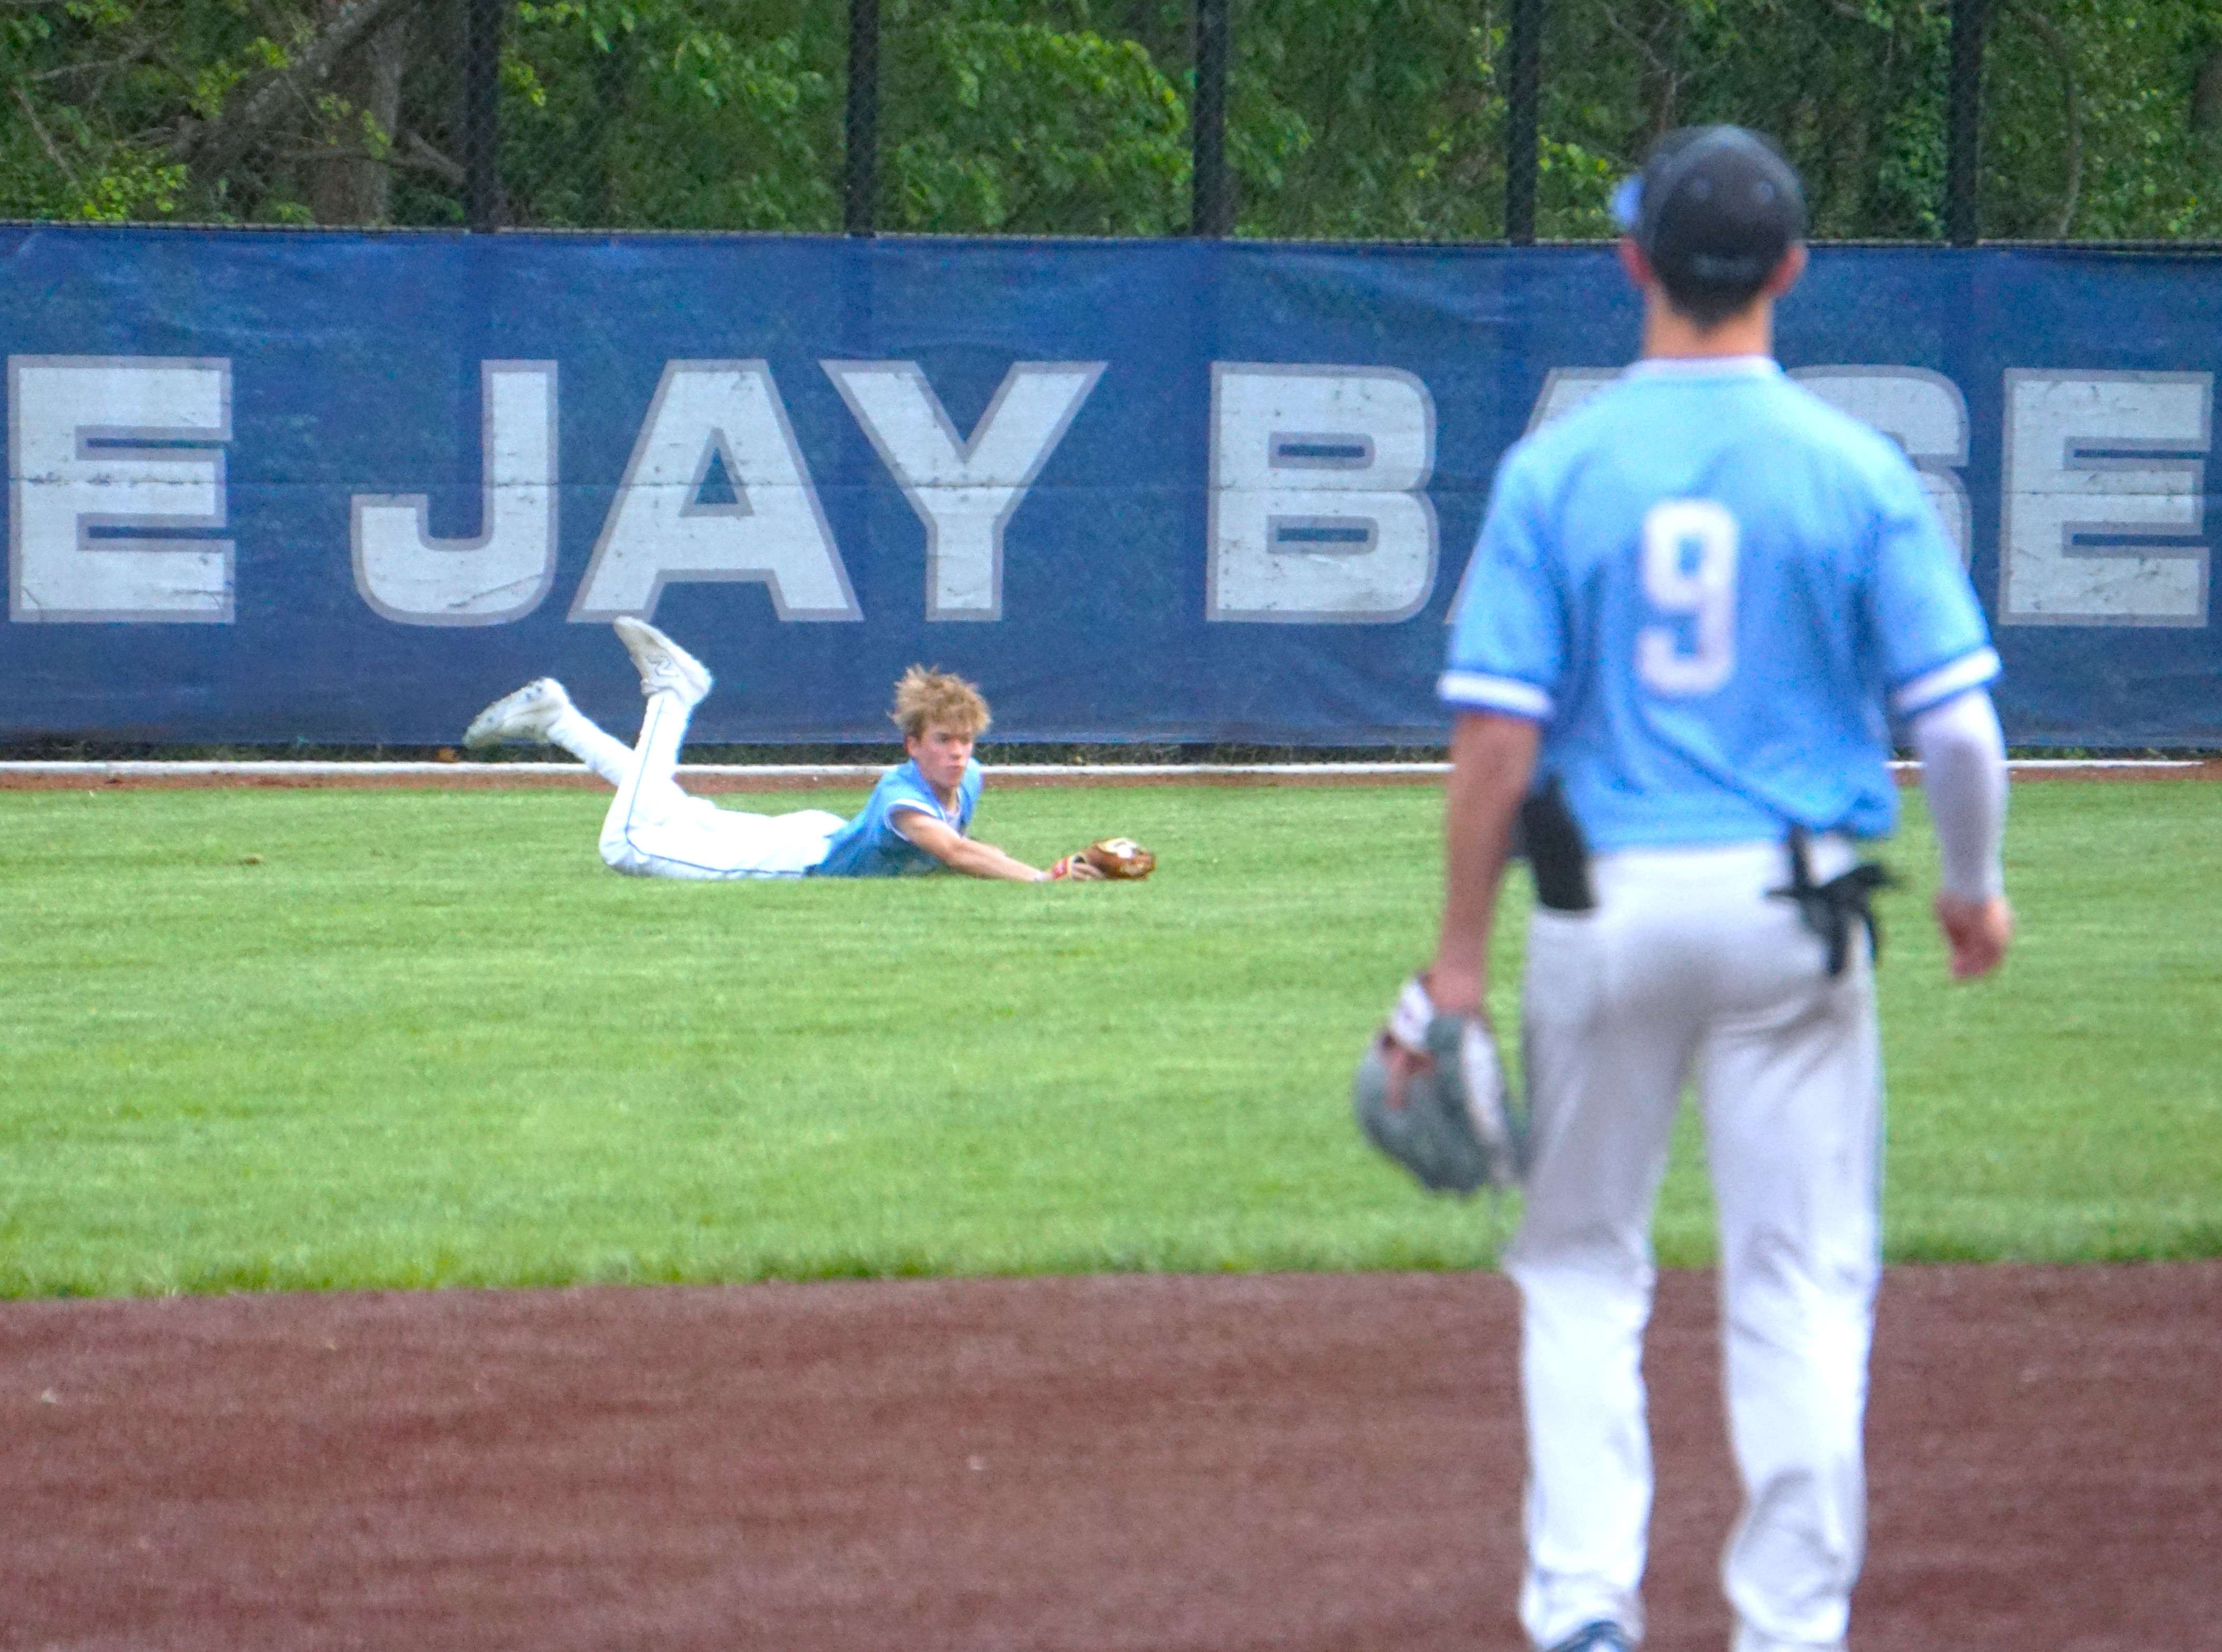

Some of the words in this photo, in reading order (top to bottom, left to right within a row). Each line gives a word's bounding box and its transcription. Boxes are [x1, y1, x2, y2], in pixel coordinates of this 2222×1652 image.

[7, 354, 236, 624] E
[351, 359, 1109, 627] JAY
[1206, 361, 2214, 628] BE
[1636, 499, 1738, 697] 9
